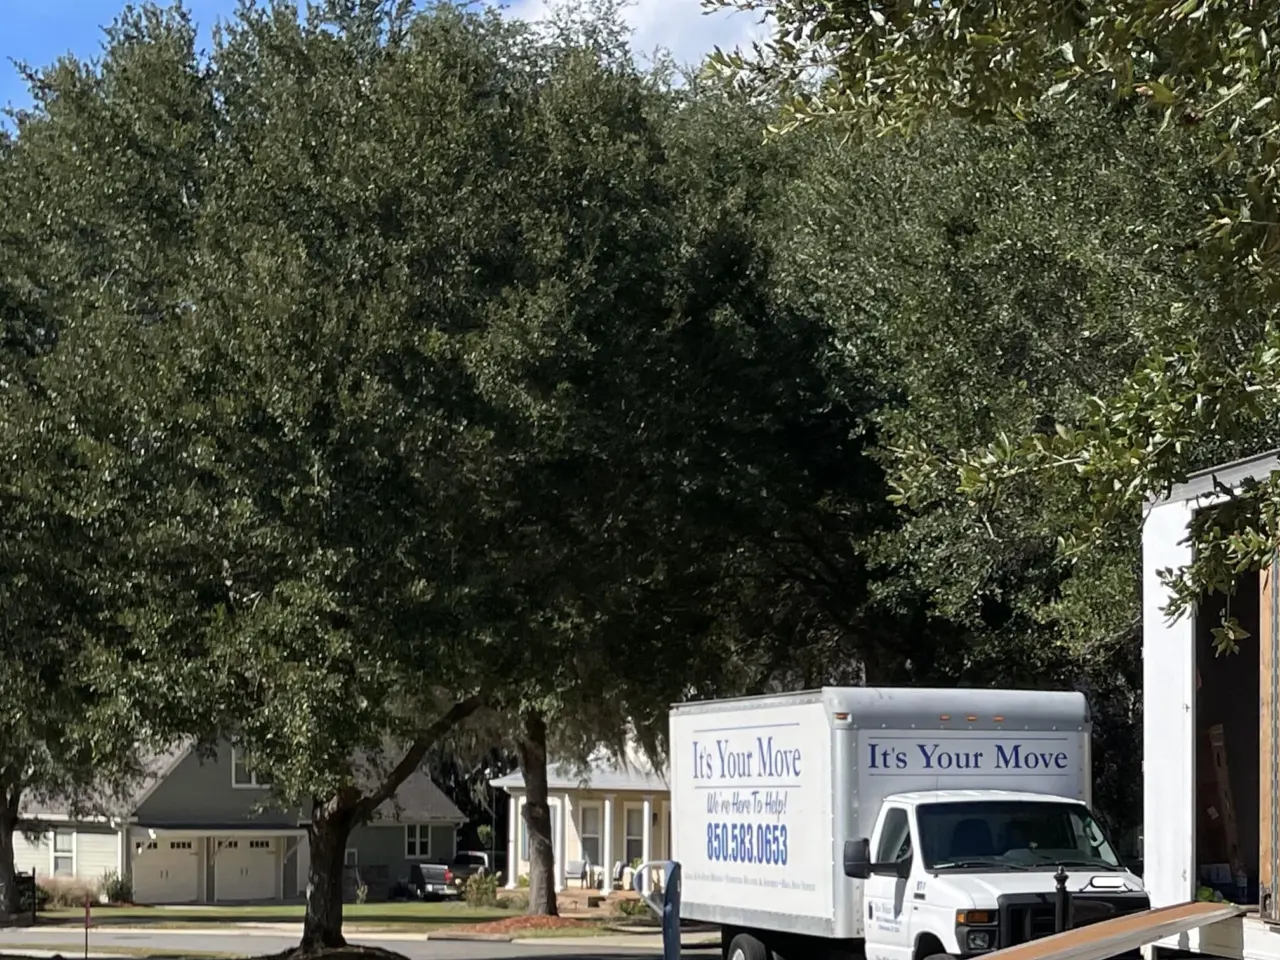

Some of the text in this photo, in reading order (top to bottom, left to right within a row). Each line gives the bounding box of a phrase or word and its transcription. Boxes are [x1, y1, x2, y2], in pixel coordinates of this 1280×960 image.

[692, 736, 802, 779] It's Your Move
[868, 743, 1068, 770] It's Your Move
[706, 790, 788, 823] We're Here To Help!
[706, 822, 789, 867] 850.583.0653
